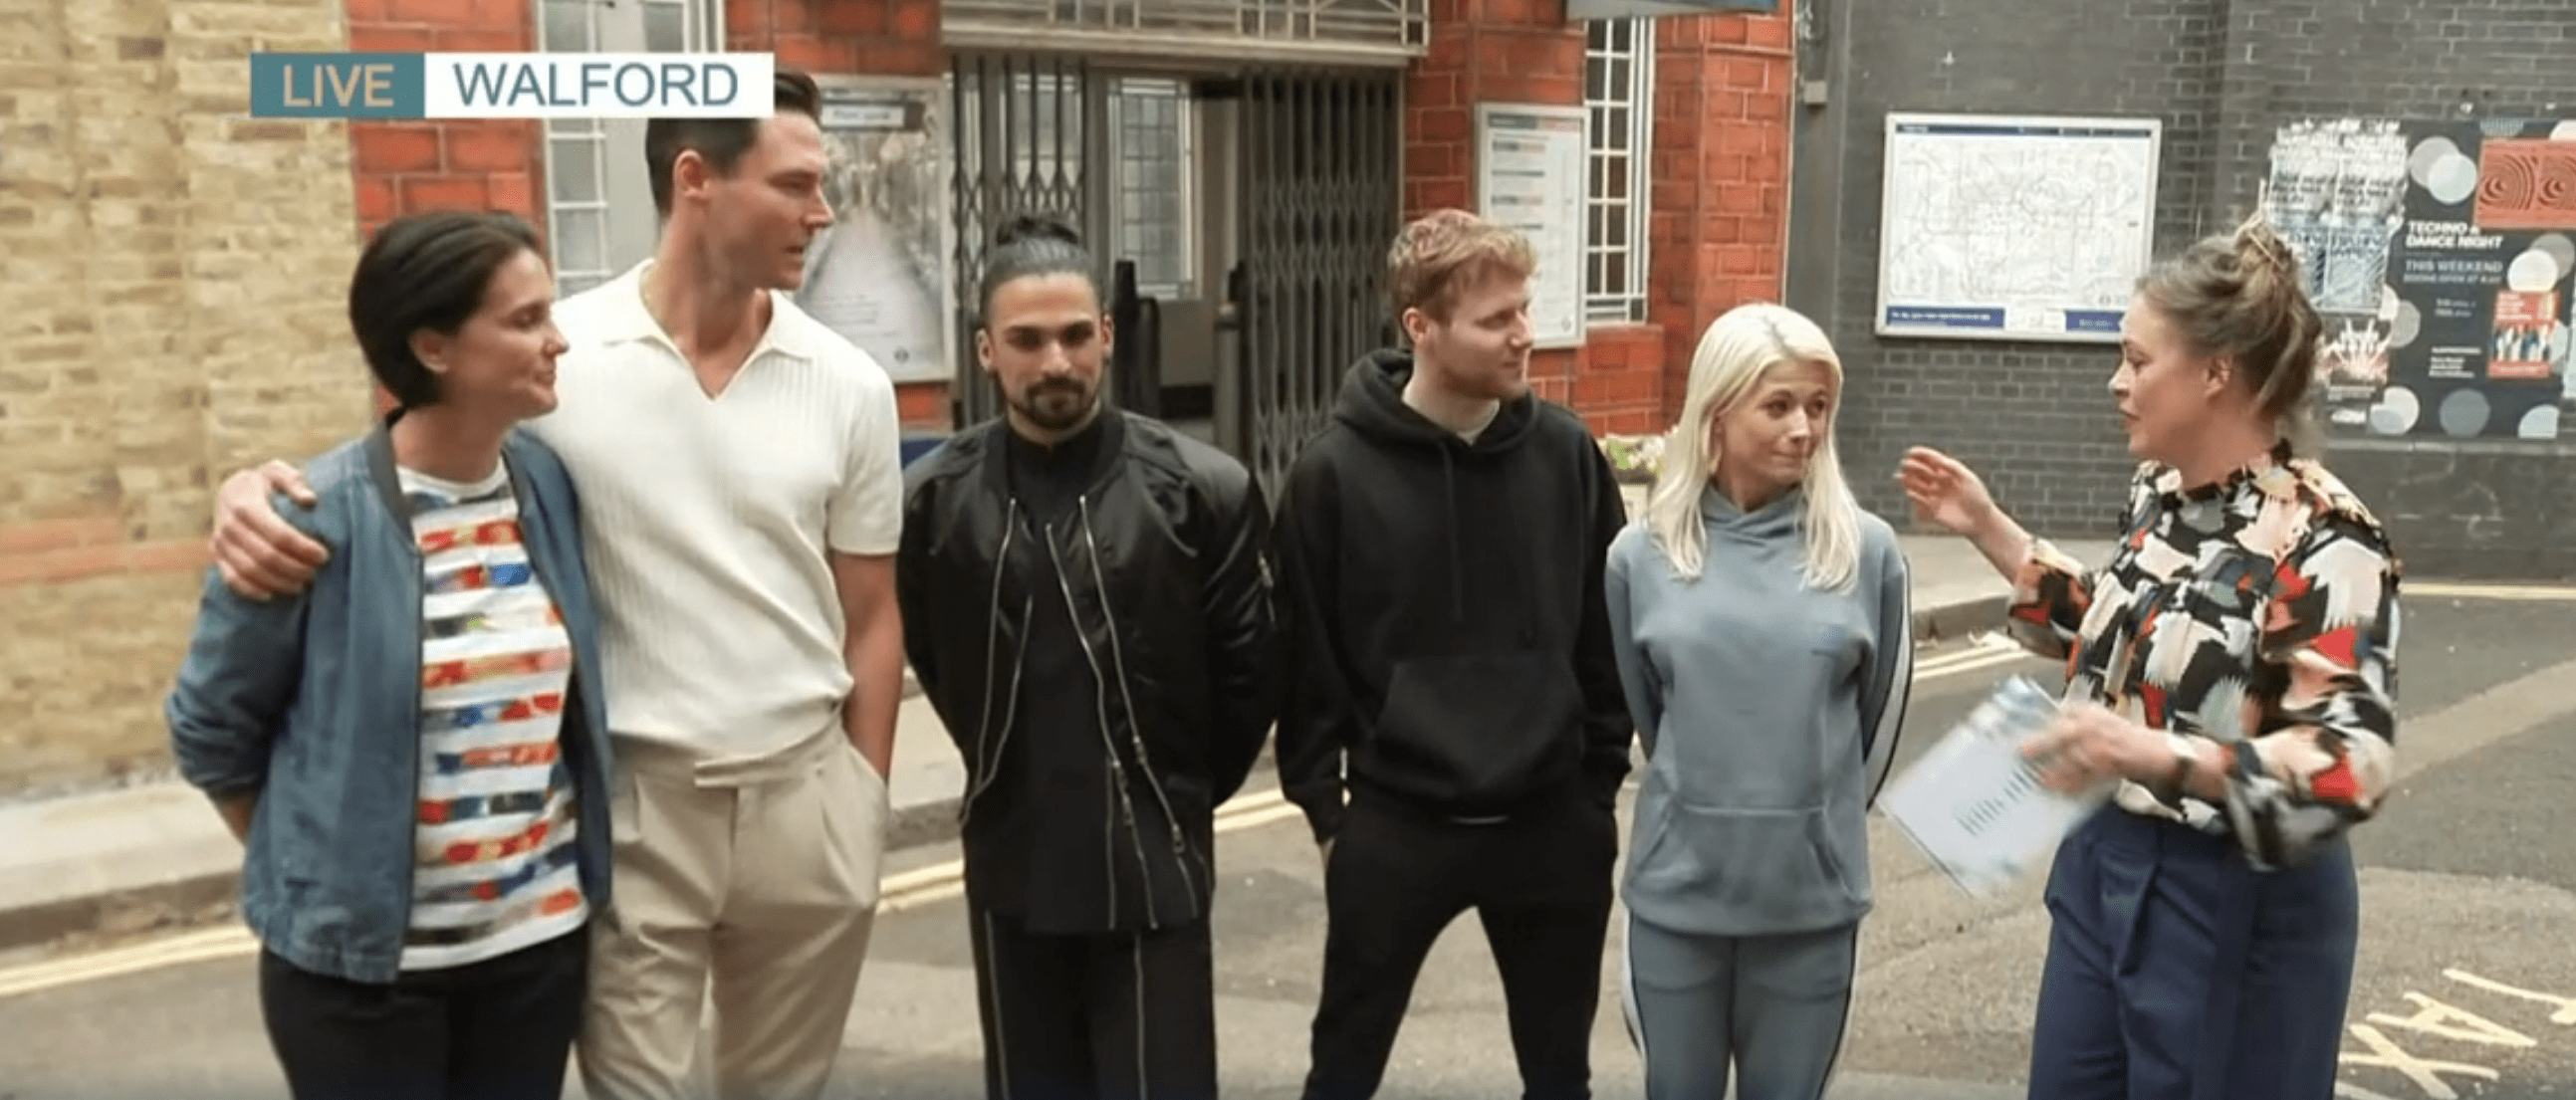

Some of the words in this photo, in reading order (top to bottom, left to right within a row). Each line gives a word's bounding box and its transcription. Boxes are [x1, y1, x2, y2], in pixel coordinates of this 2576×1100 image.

[2409, 221, 2467, 235] TECHNO
[2406, 235, 2455, 249] DANCE
[2458, 235, 2504, 249] NIGHT
[2406, 260, 2435, 272] THIS
[2438, 260, 2503, 273] WEEKEND
